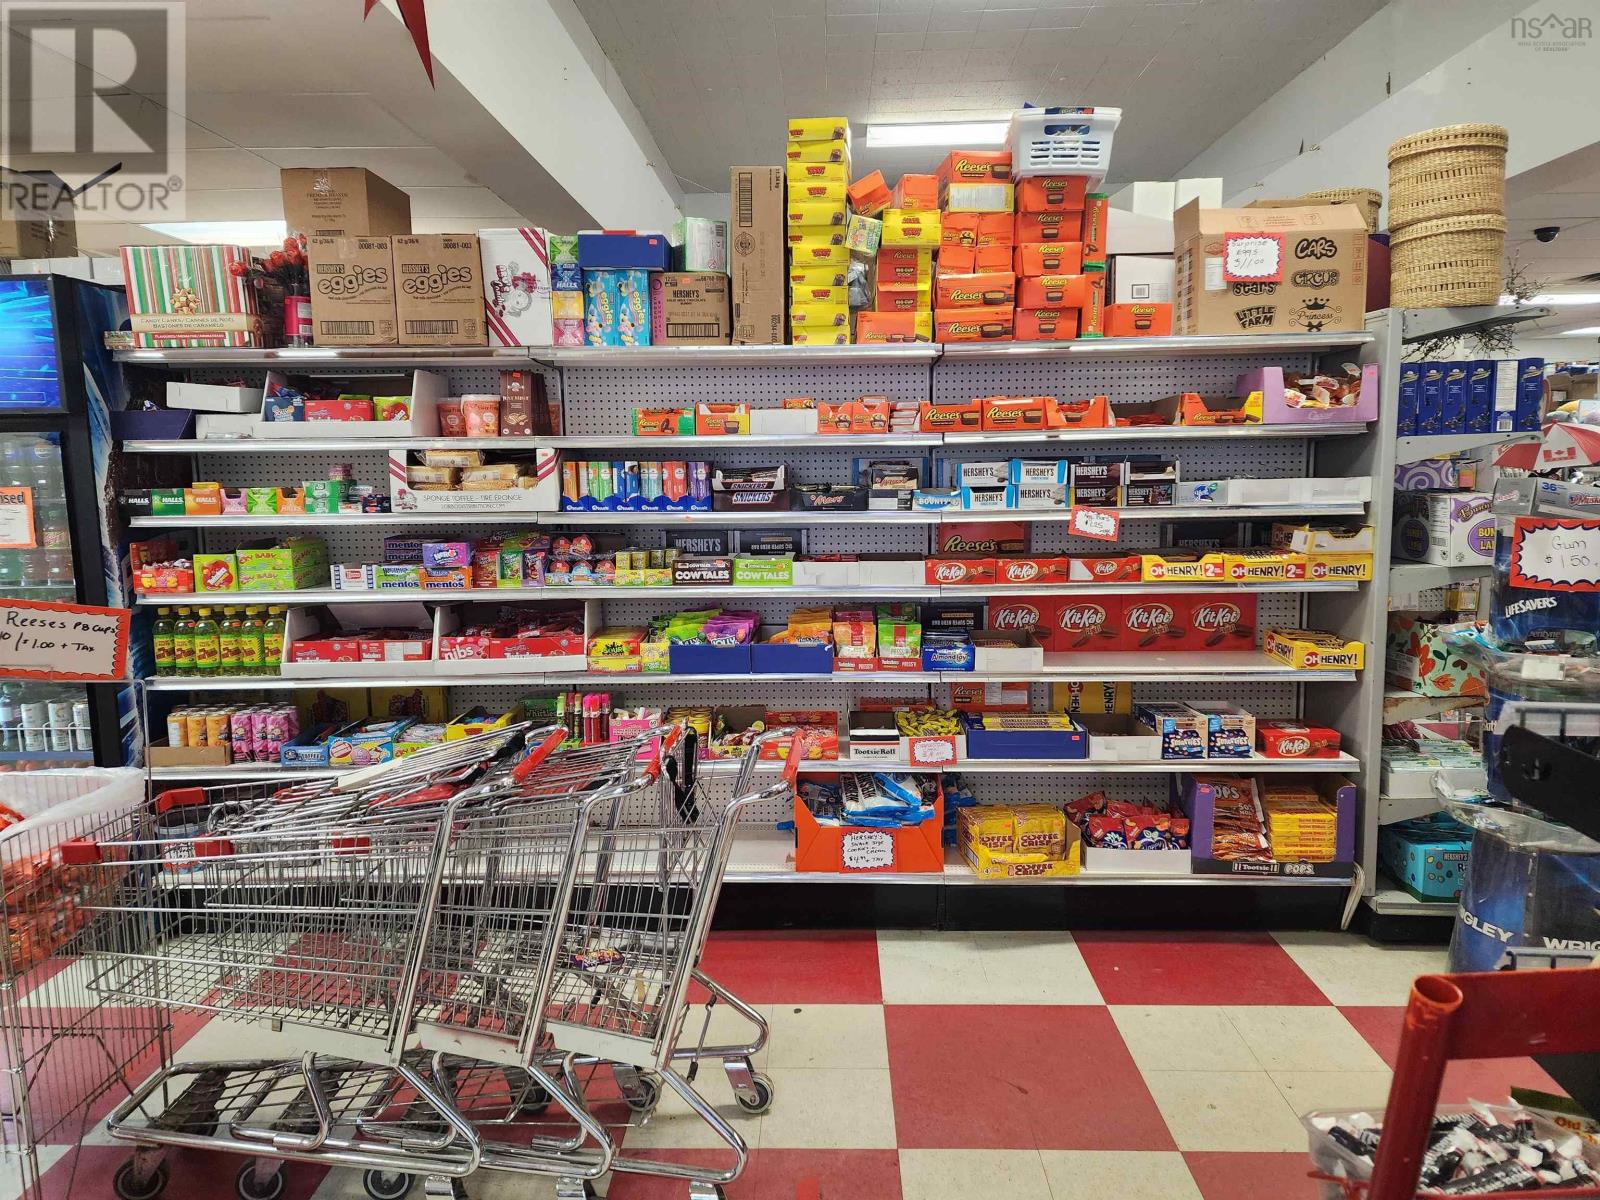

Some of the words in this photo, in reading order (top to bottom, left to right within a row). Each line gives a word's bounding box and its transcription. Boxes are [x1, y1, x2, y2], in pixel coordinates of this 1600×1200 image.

[955, 159, 992, 172] Reese's
[1042, 178, 1068, 188] Reese's
[1037, 213, 1063, 223] Reese's
[1038, 244, 1065, 254] Reese's
[1295, 237, 1337, 259] CARS
[317, 264, 345, 274] HERSHEY'S
[318, 265, 388, 294] eggies
[403, 265, 473, 294] eggies
[1041, 277, 1068, 287] Reese's
[673, 289, 700, 299] HERSHEY'S
[951, 289, 983, 300] Reese's
[601, 292, 613, 325] eggies
[634, 291, 646, 325] eggies
[1131, 304, 1156, 315] Reese's
[1034, 310, 1061, 319] Reese's
[1297, 309, 1333, 323] Princess
[949, 322, 981, 333] Reese's
[1240, 316, 1274, 329] FARM
[925, 408, 961, 421] Reese's
[987, 407, 1023, 419] Reese's
[963, 467, 994, 477] HERSHEY'S
[1025, 468, 1054, 477] HERSHEY'S
[1076, 466, 1108, 476] HERSHEY'S
[1542, 482, 1557, 491] 36
[974, 492, 1003, 502] HERSHEY'S
[1020, 489, 1051, 499] HERSHEY'S
[1076, 488, 1106, 498] HERSHEY'S
[675, 538, 721, 552] HERSHEY'S
[945, 536, 997, 552] Reese's
[1552, 535, 1587, 551] Gum
[1151, 566, 1167, 576] OH
[1167, 565, 1203, 577] HENRY!
[1205, 565, 1215, 577] 2
[1231, 566, 1247, 577] OH
[1247, 565, 1284, 577] HENRY!
[1287, 565, 1297, 577] 2
[1312, 566, 1328, 576] OH
[1328, 564, 1366, 576] HENRY!
[73, 622, 90, 631] PB
[444, 646, 474, 660] nibs
[931, 653, 957, 662] Almond
[1304, 656, 1320, 665] OH
[1321, 654, 1358, 665] HENRY!
[1443, 853, 1468, 861] HERSHEY'S
[1015, 863, 1054, 871] COFFEE
